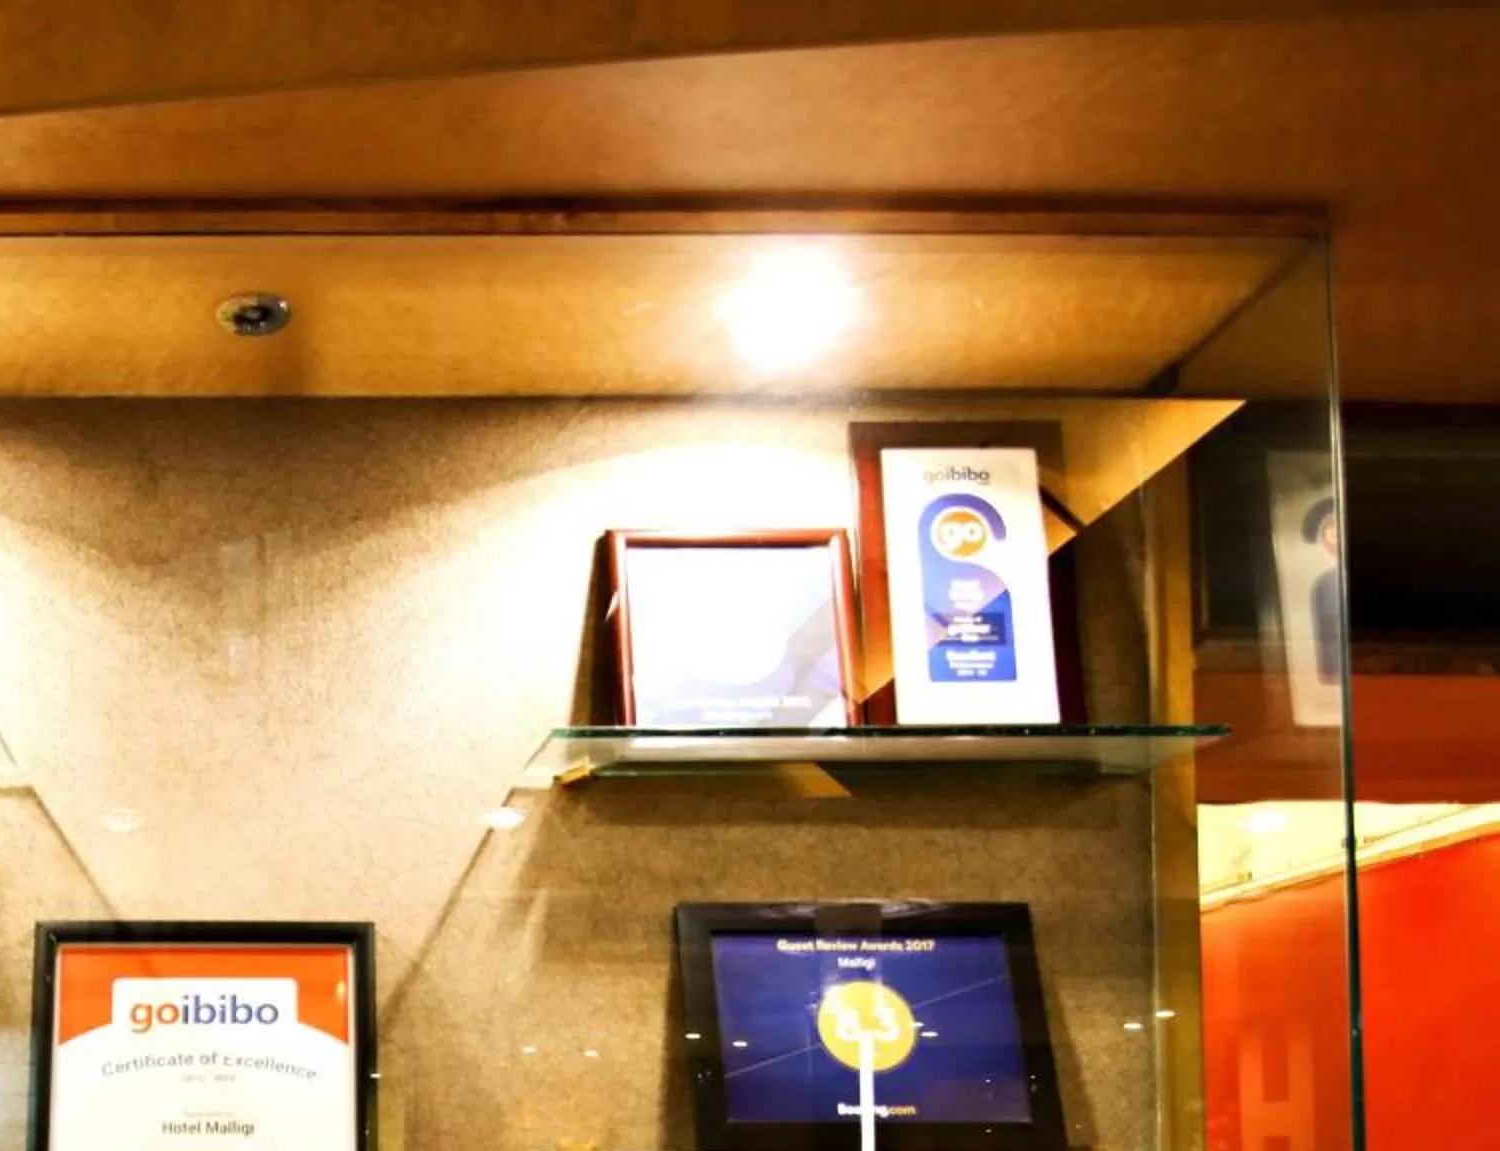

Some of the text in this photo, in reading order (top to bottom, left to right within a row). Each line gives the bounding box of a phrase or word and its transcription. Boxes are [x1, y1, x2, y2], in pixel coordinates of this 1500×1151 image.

[129, 994, 279, 1034] goibibo
[101, 1053, 194, 1077] Certificate
[199, 1051, 218, 1066] of
[162, 1120, 201, 1135] Hotel
